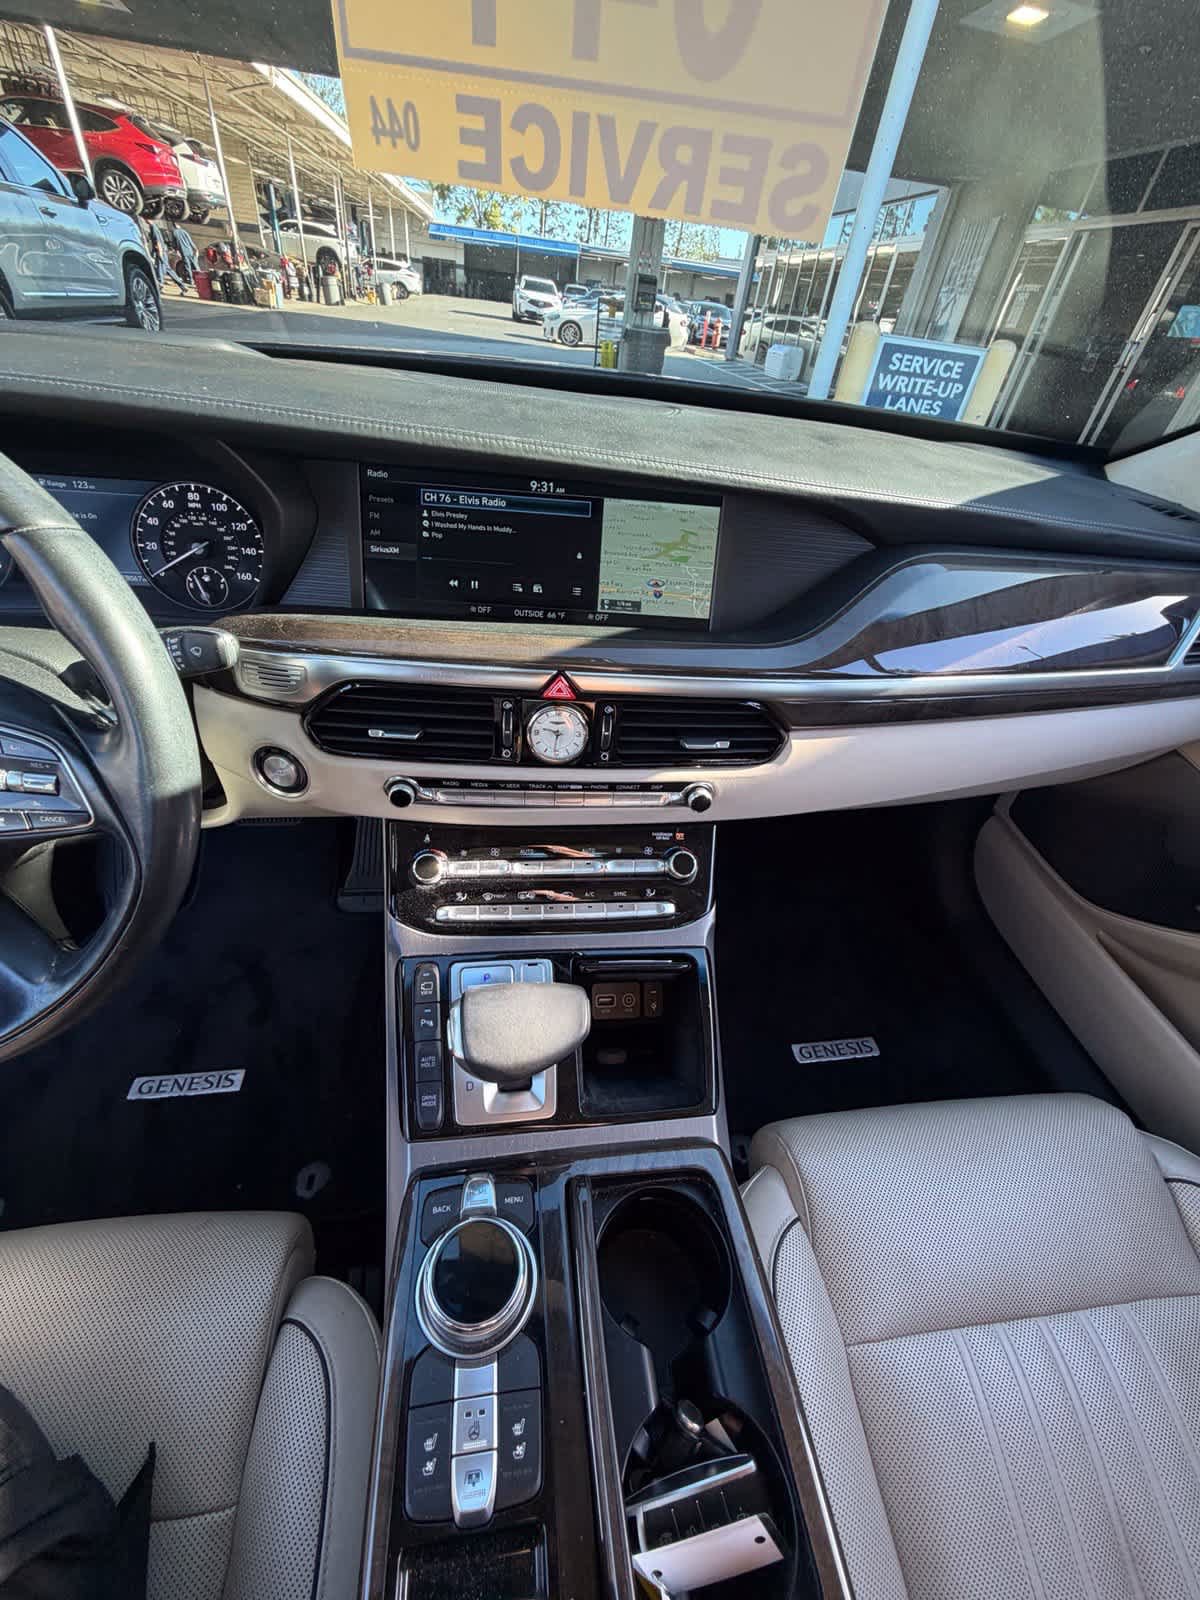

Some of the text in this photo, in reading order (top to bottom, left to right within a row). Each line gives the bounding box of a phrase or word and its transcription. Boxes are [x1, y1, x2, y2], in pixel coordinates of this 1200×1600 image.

[888, 352, 965, 379] SERVICE
[878, 372, 964, 399] WRITE-UP
[884, 394, 943, 416] LANES
[367, 469, 389, 479] Radio
[72, 480, 89, 489] 123
[529, 480, 554, 493] 9:31
[187, 492, 200, 501] 80
[424, 492, 437, 502] CH
[439, 494, 452, 503] 76
[459, 495, 480, 505] Elvis
[481, 496, 507, 507] Radio
[162, 500, 175, 509] 60
[211, 503, 228, 512] 100
[146, 517, 159, 526] 40
[231, 522, 247, 531] 120
[144, 542, 158, 551] 20
[240, 547, 257, 556] 140
[236, 572, 253, 581] 160
[477, 606, 492, 614] OFF
[513, 609, 544, 618] OUTSIDE
[546, 611, 556, 619] 66
[594, 613, 609, 621] OFF
[40, 816, 67, 824] CANCEL
[483, 973, 491, 982] P
[797, 1039, 874, 1059] GENESIS
[137, 1072, 237, 1095] GENESIS
[504, 1196, 524, 1204] MENU
[432, 1205, 451, 1214] BACK
